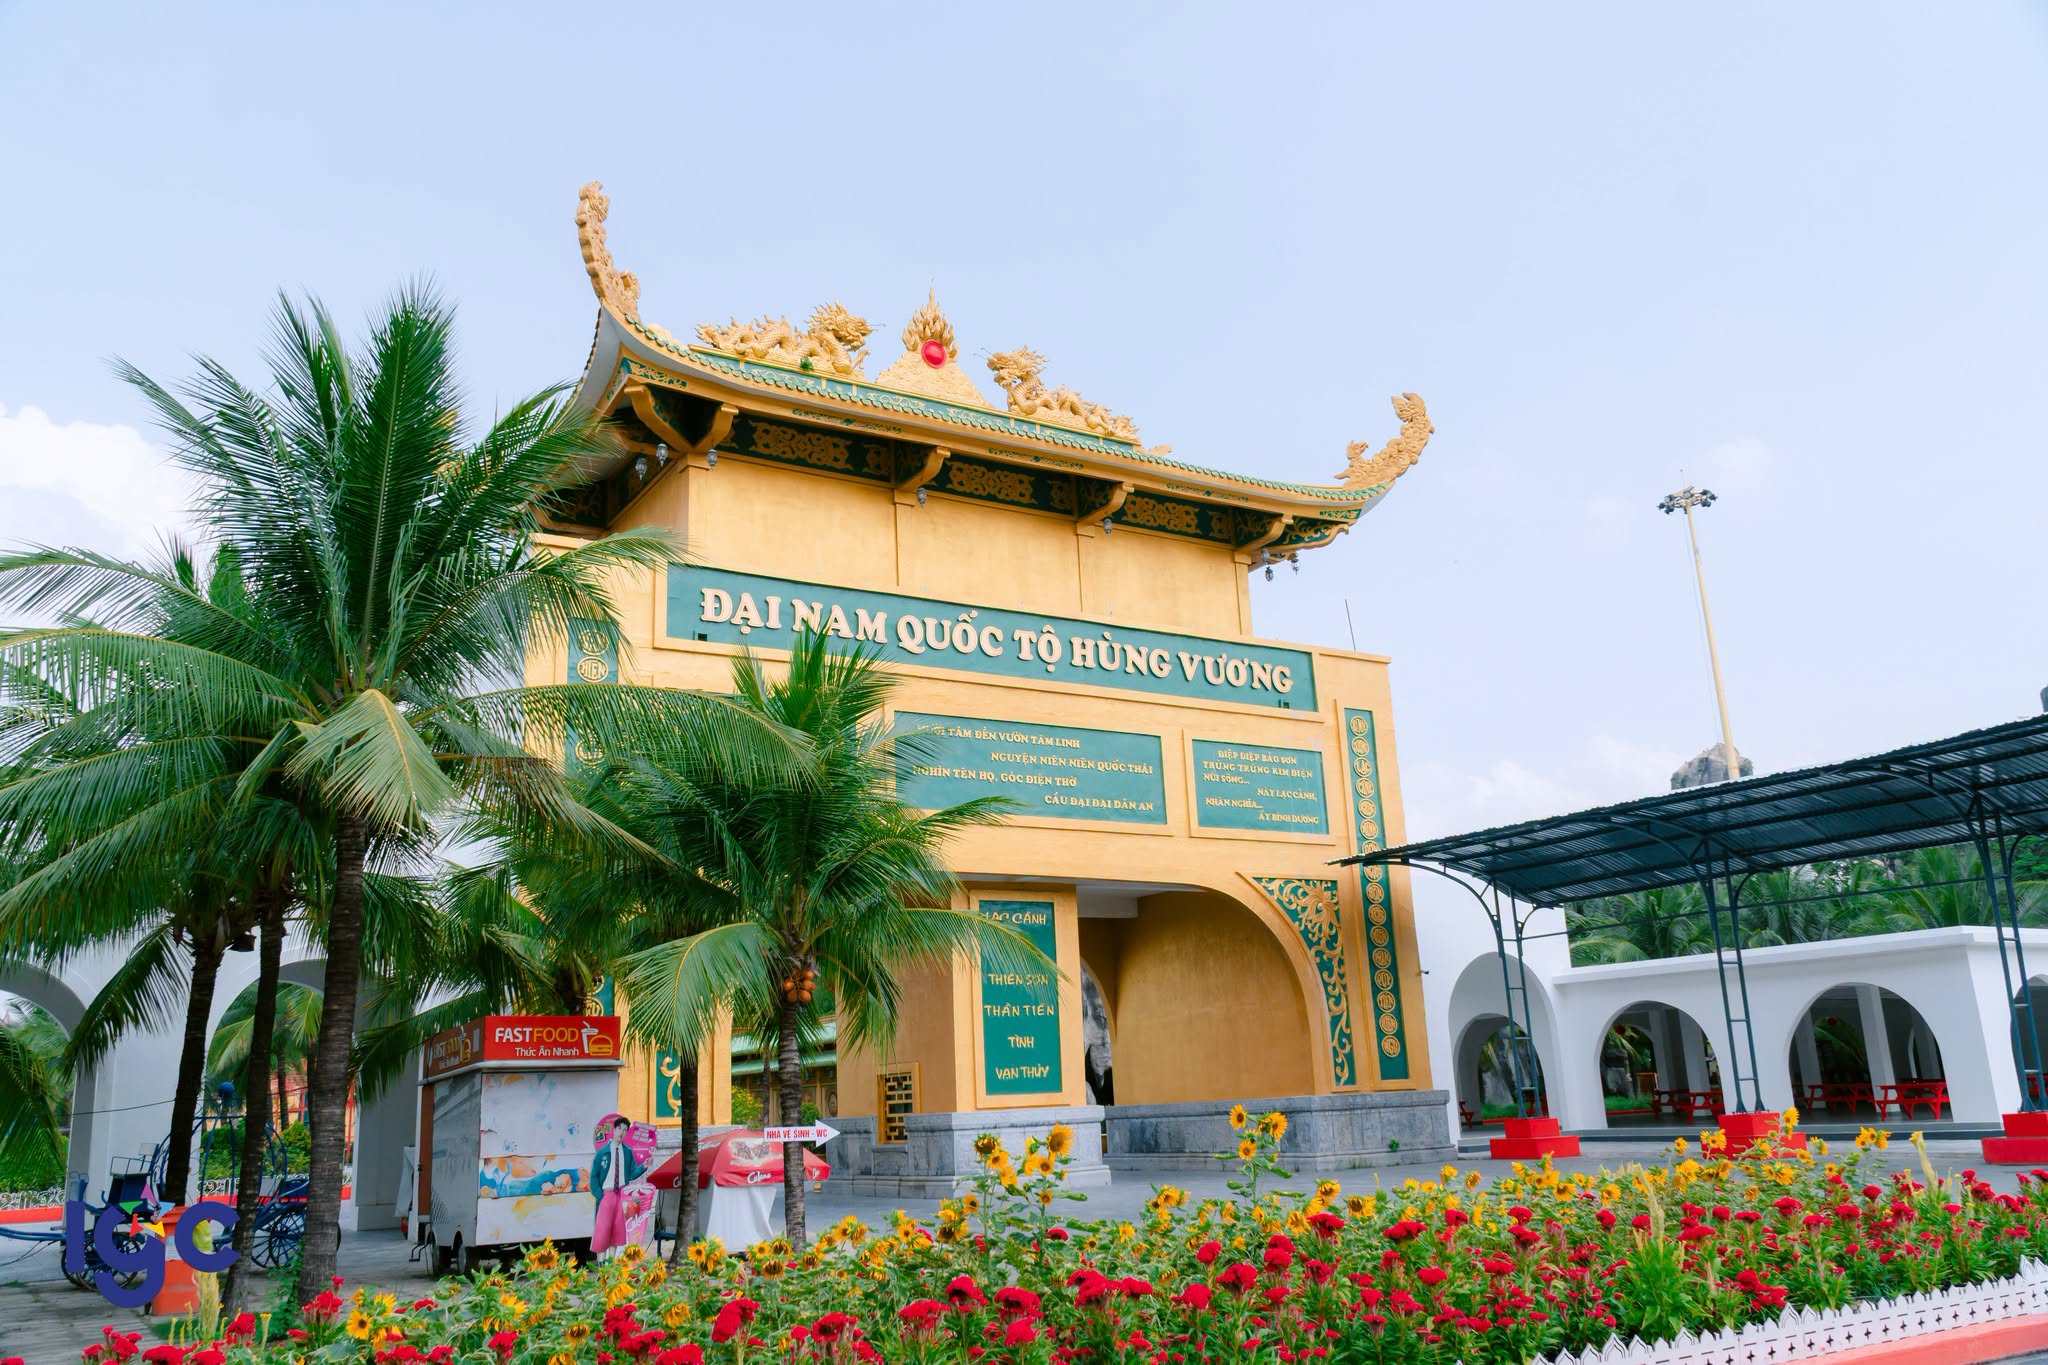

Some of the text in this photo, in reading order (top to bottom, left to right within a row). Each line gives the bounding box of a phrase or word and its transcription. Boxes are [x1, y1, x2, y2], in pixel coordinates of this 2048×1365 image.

[700, 587, 1293, 693] ĐẠI NAM QUỐC TỘ HÙNG VƯƠNG
[1055, 738, 1081, 748] LINH
[1097, 759, 1126, 772] QUỐC
[1138, 801, 1153, 811] AN
[515, 1045, 579, 1057] Thức Ăn Nhanh
[793, 1129, 810, 1139] SINH
[815, 1128, 828, 1138] WC
